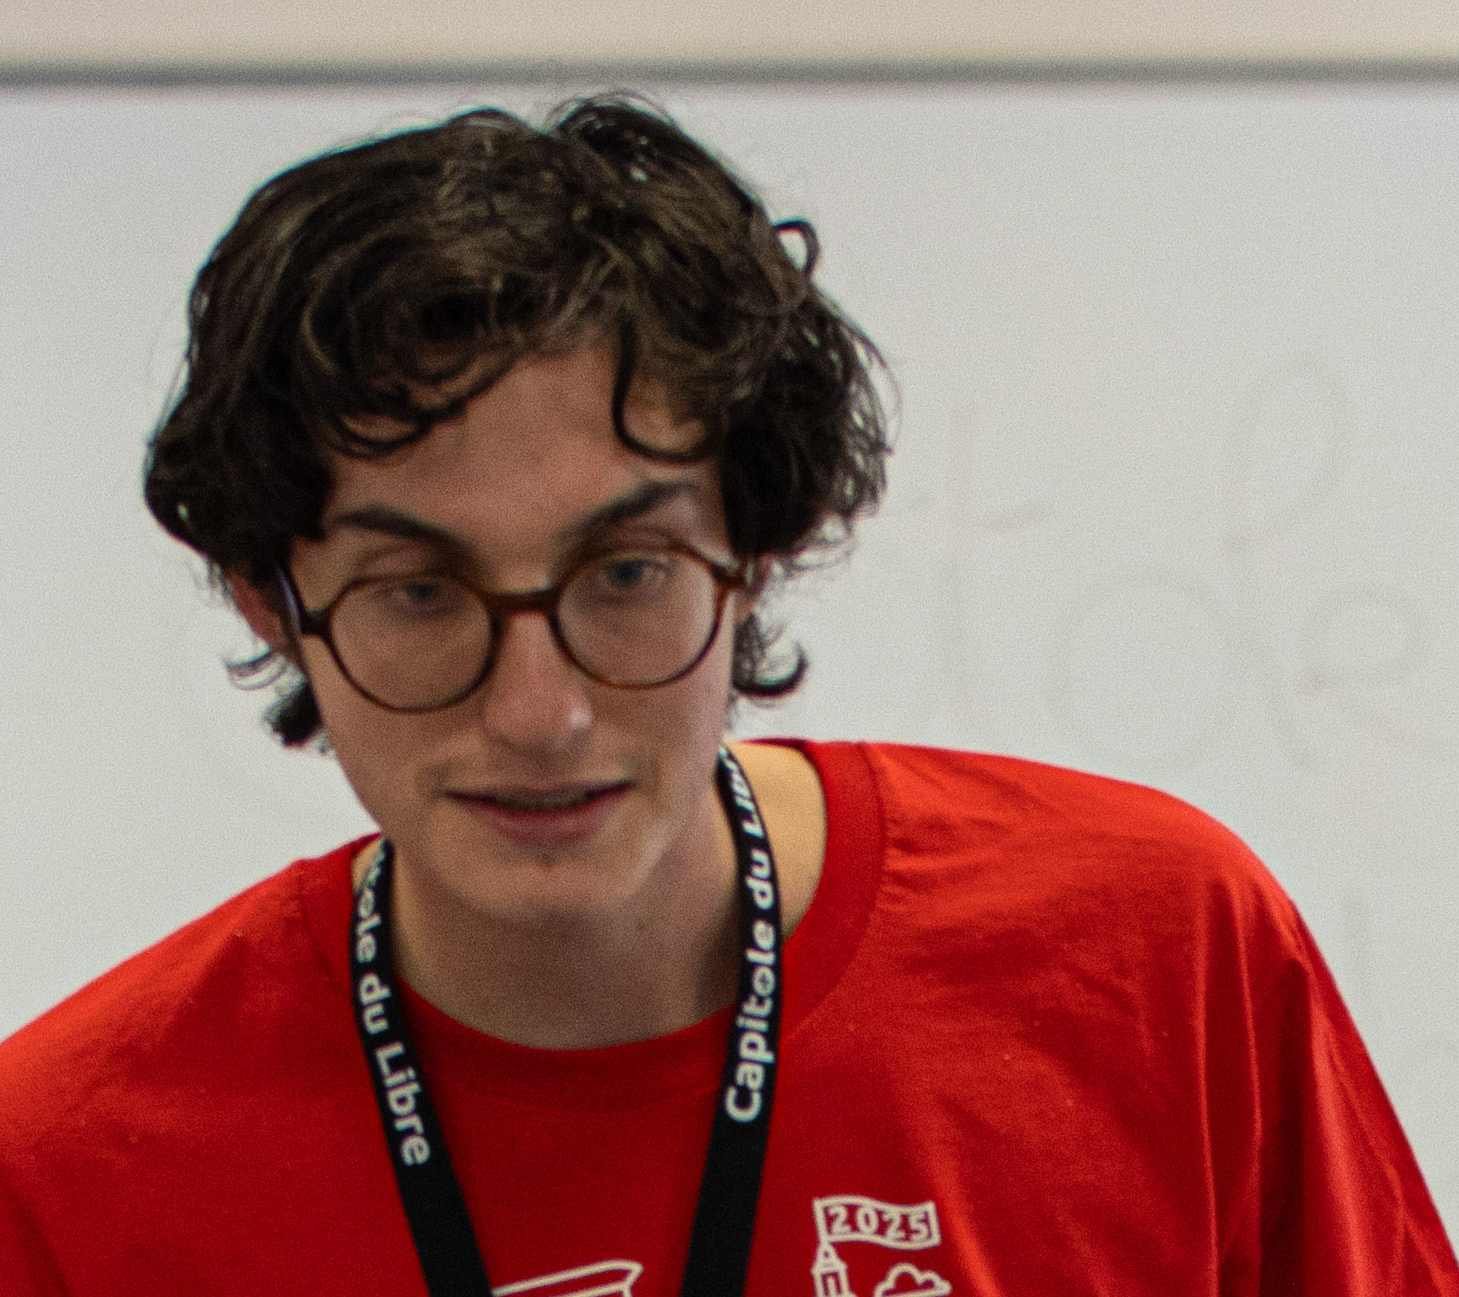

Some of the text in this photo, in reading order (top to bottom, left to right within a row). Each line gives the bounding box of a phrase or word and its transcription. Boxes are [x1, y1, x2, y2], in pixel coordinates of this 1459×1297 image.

[744, 848, 776, 911] du
[358, 972, 392, 1036] du
[724, 919, 777, 1123] Capitole
[374, 1041, 432, 1167] Libre
[827, 1203, 931, 1243] 2025
